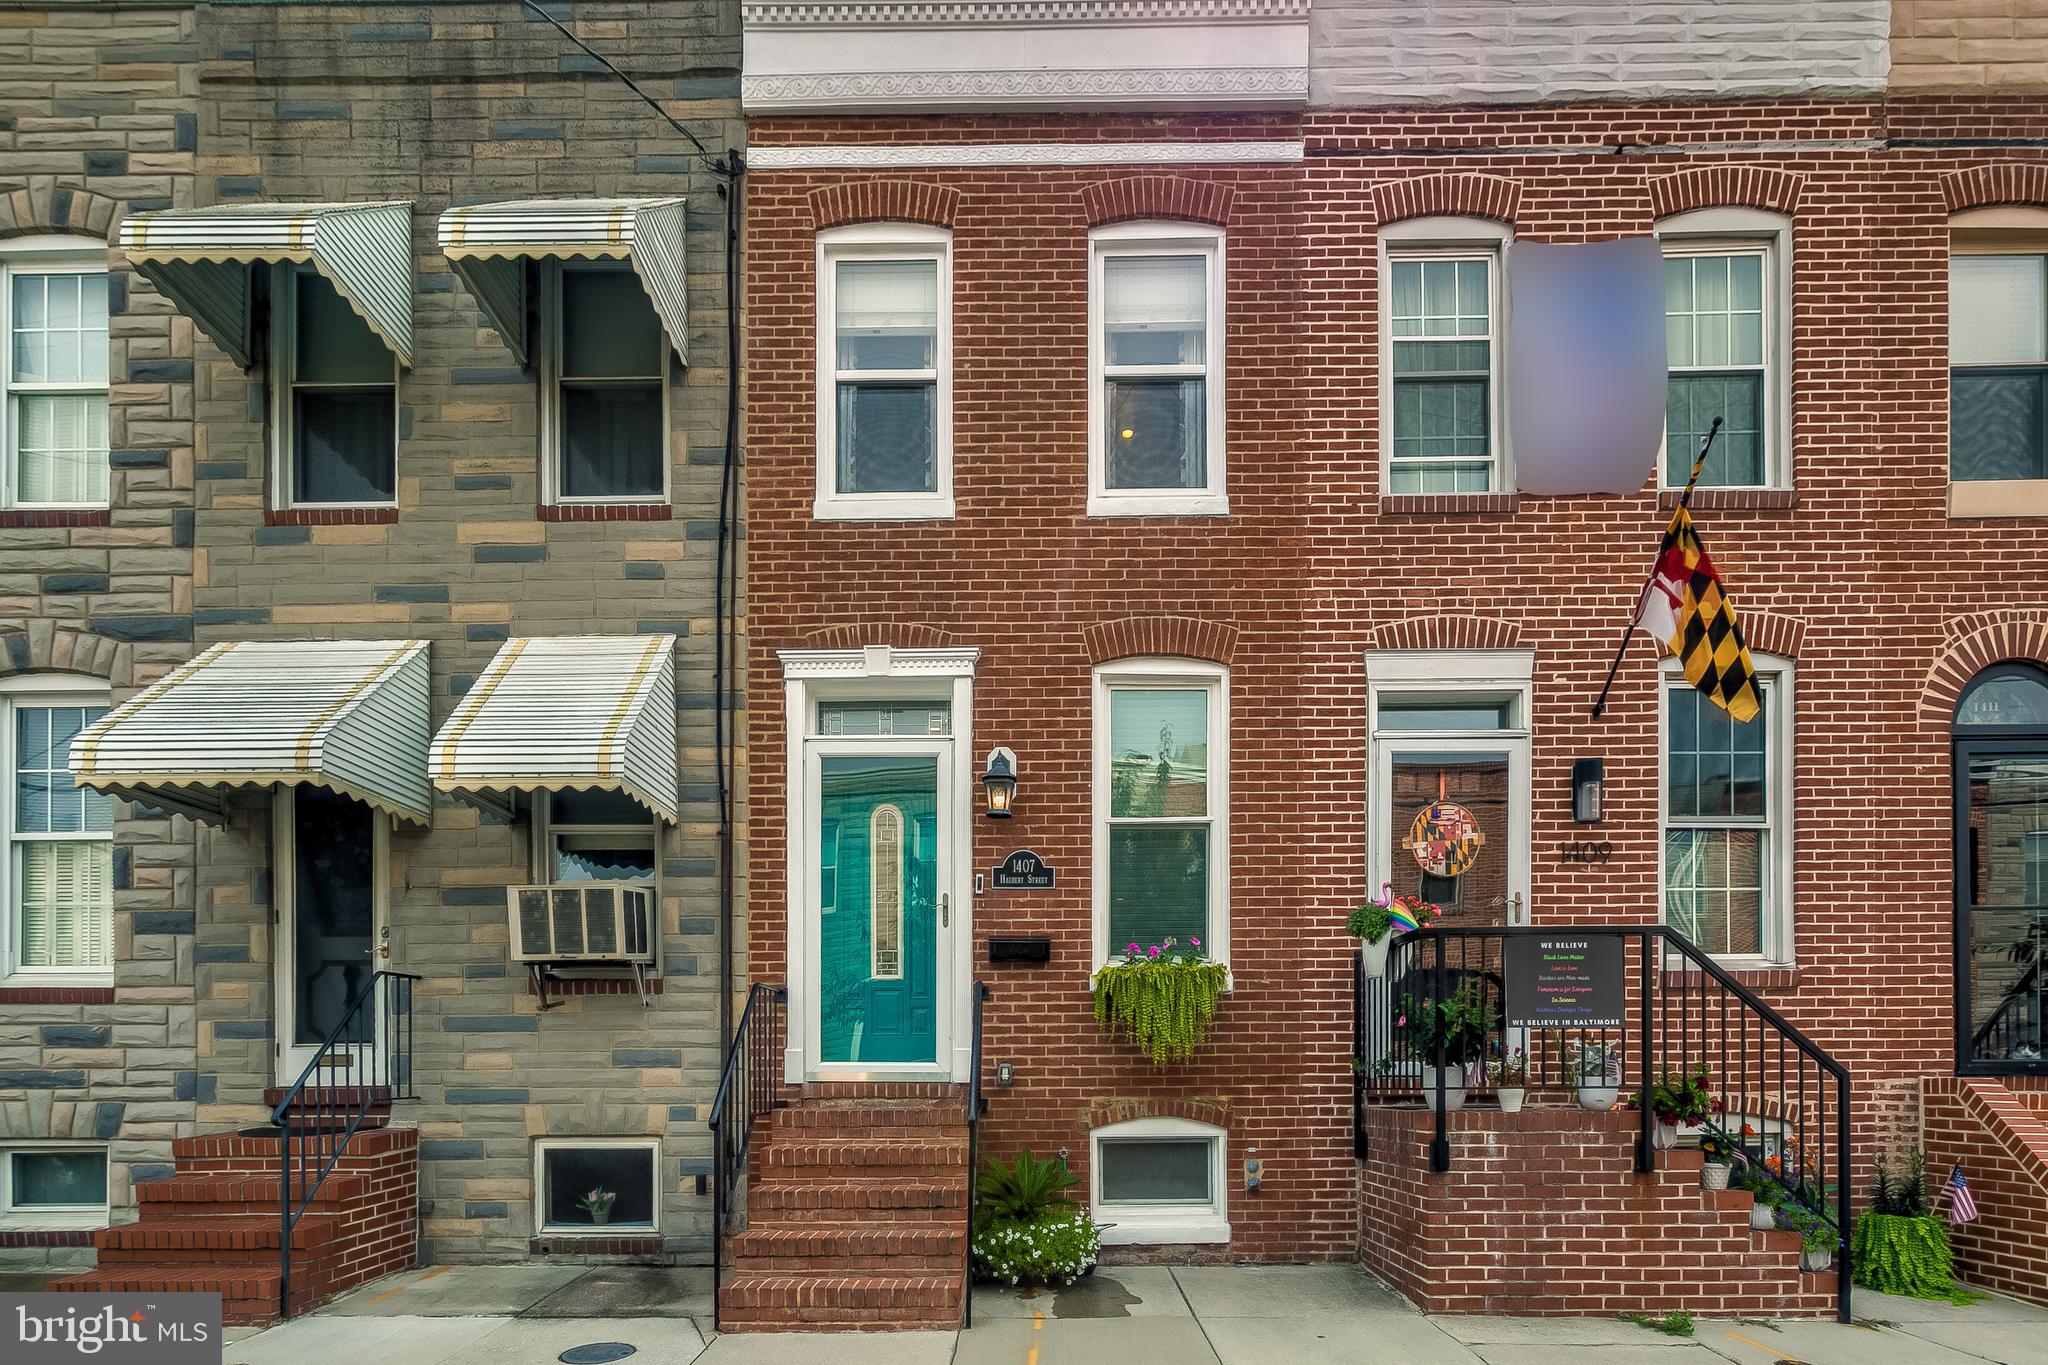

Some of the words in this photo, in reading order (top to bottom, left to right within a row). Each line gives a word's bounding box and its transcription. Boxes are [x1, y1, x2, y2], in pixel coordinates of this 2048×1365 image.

[1974, 702, 2000, 712] 1411
[1561, 841, 1612, 864] 1409
[1012, 859, 1035, 873] 1407
